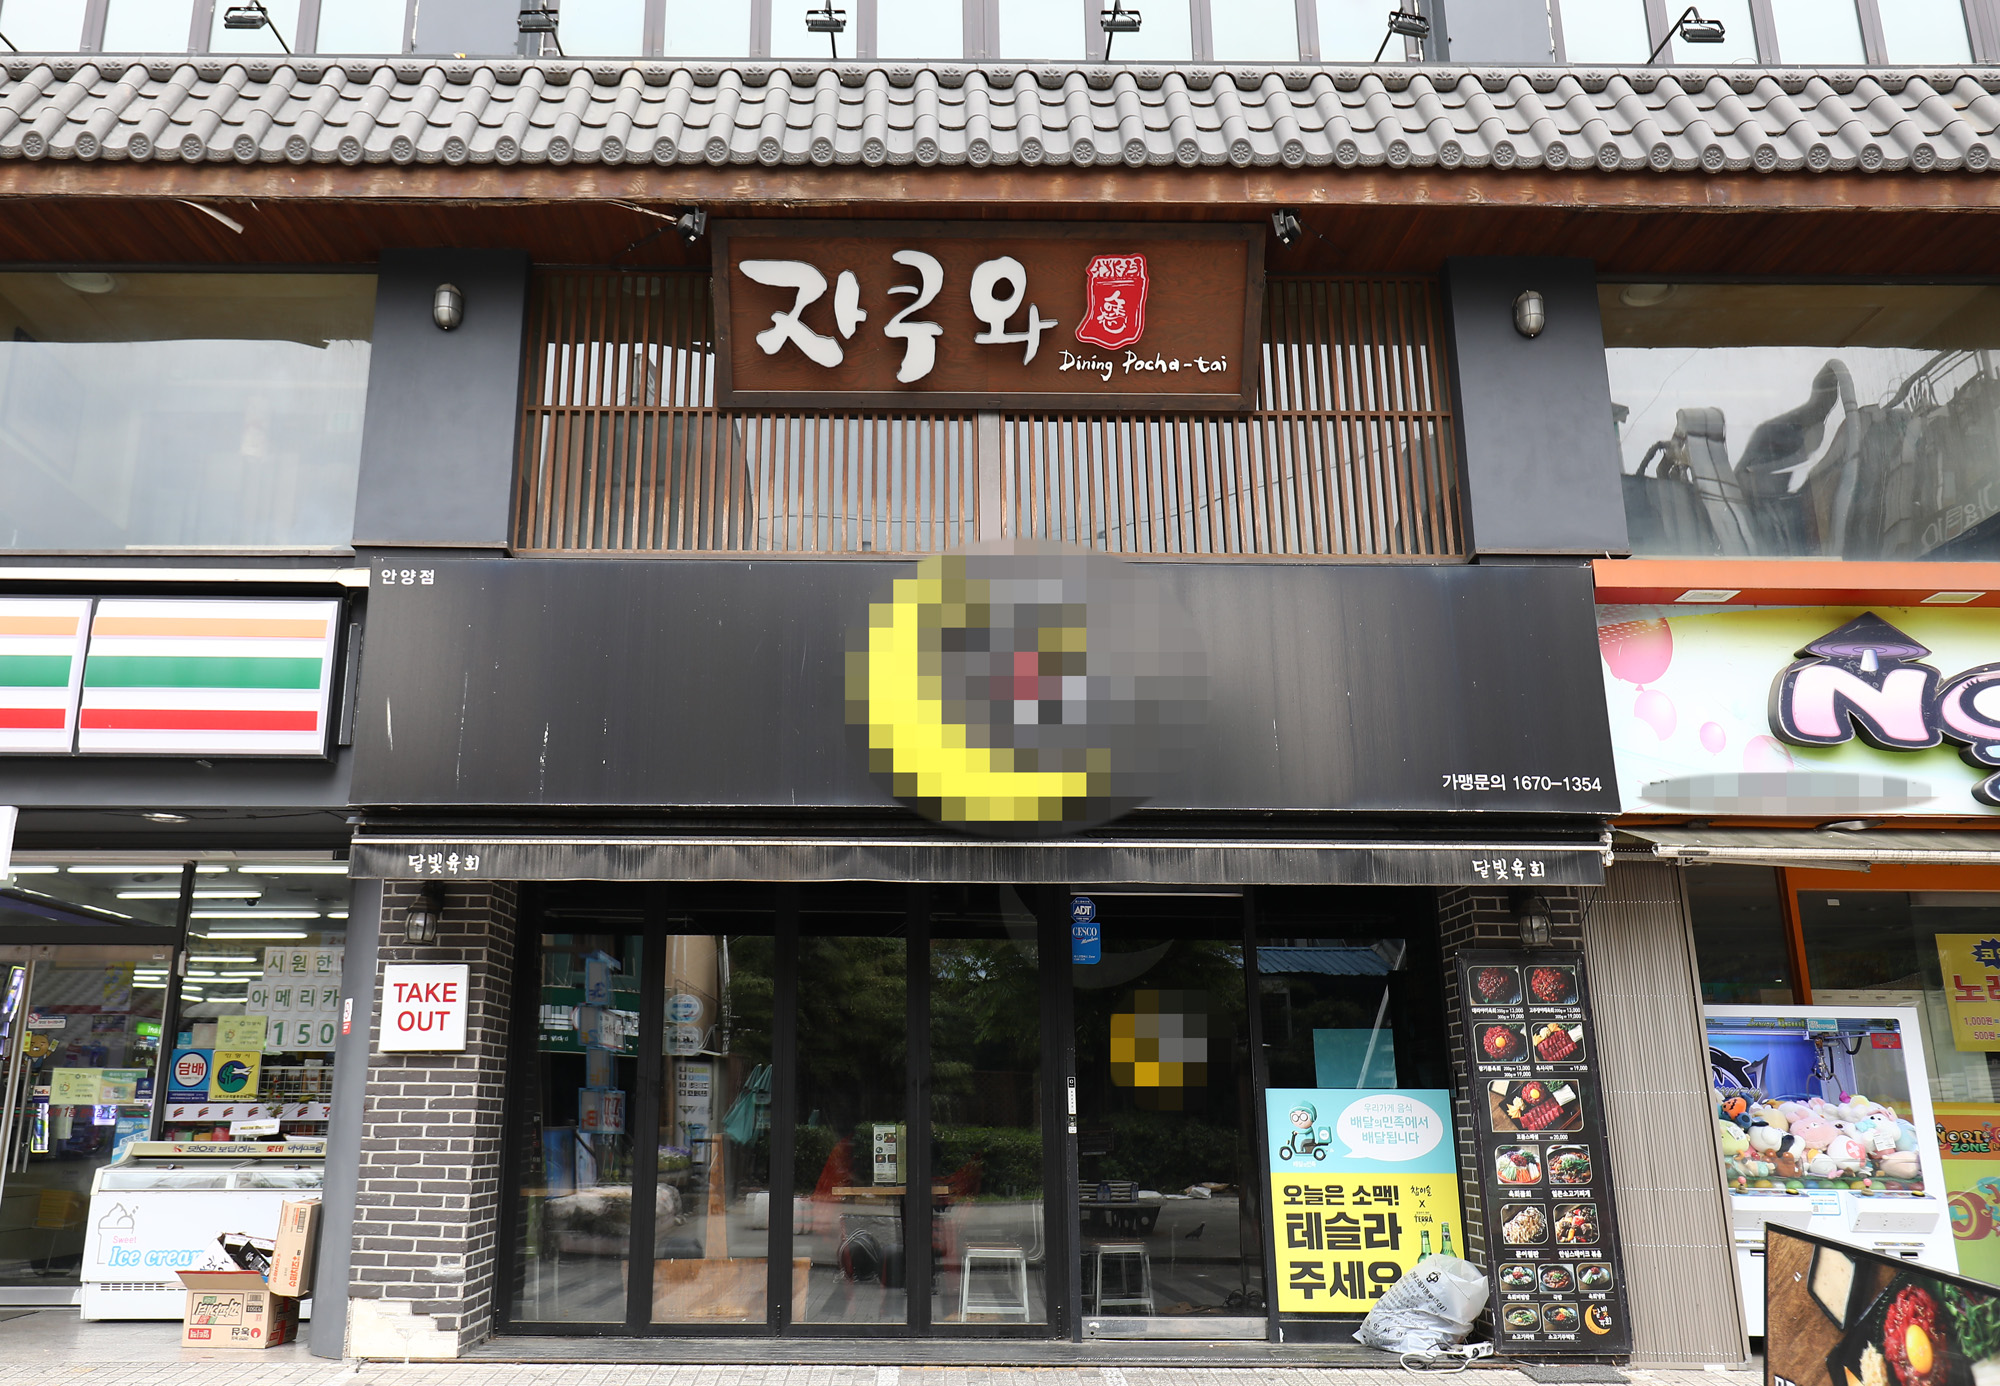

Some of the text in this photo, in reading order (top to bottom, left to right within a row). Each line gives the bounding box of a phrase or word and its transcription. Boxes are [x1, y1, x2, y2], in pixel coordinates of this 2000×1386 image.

[1059, 350, 1228, 381] Dining Pocha-tai
[381, 569, 435, 585] 안양점
[1442, 774, 1602, 792] 가맹문의 1670-1354
[408, 853, 480, 874] 달빛육회
[1472, 858, 1545, 880] 달빛육회
[1074, 906, 1091, 915] ADT
[1072, 927, 1097, 936] CESCO
[268, 954, 333, 973] 시원한
[252, 988, 339, 1007] 아메리카
[393, 983, 457, 1002] TAKE
[397, 1011, 450, 1031] OUT
[1974, 1031, 1995, 1040] 500원
[178, 1062, 205, 1076] 담배
[1364, 1104, 1413, 1113] 우리가게 음식
[1350, 1116, 1429, 1129] 배달의민족에서
[1362, 1131, 1420, 1144] 배달됩니다
[1936, 1130, 1984, 1144] NORI
[266, 1145, 284, 1153] 롯데
[1951, 1142, 1991, 1152] ZONE
[1283, 1185, 1399, 1206] 오늘은 소맥!
[1411, 1185, 1432, 1197] 참이슬
[1419, 1200, 1426, 1208] X
[1414, 1214, 1433, 1223] TERRA
[1286, 1212, 1402, 1251] 테슬라
[113, 1235, 137, 1244] Sweet
[109, 1246, 142, 1267] Ice
[1289, 1261, 1402, 1299] 주세요
[193, 1298, 242, 1317] 짜파게티
[189, 1329, 210, 1339] 멀티팩
[232, 1327, 250, 1336] 농심
